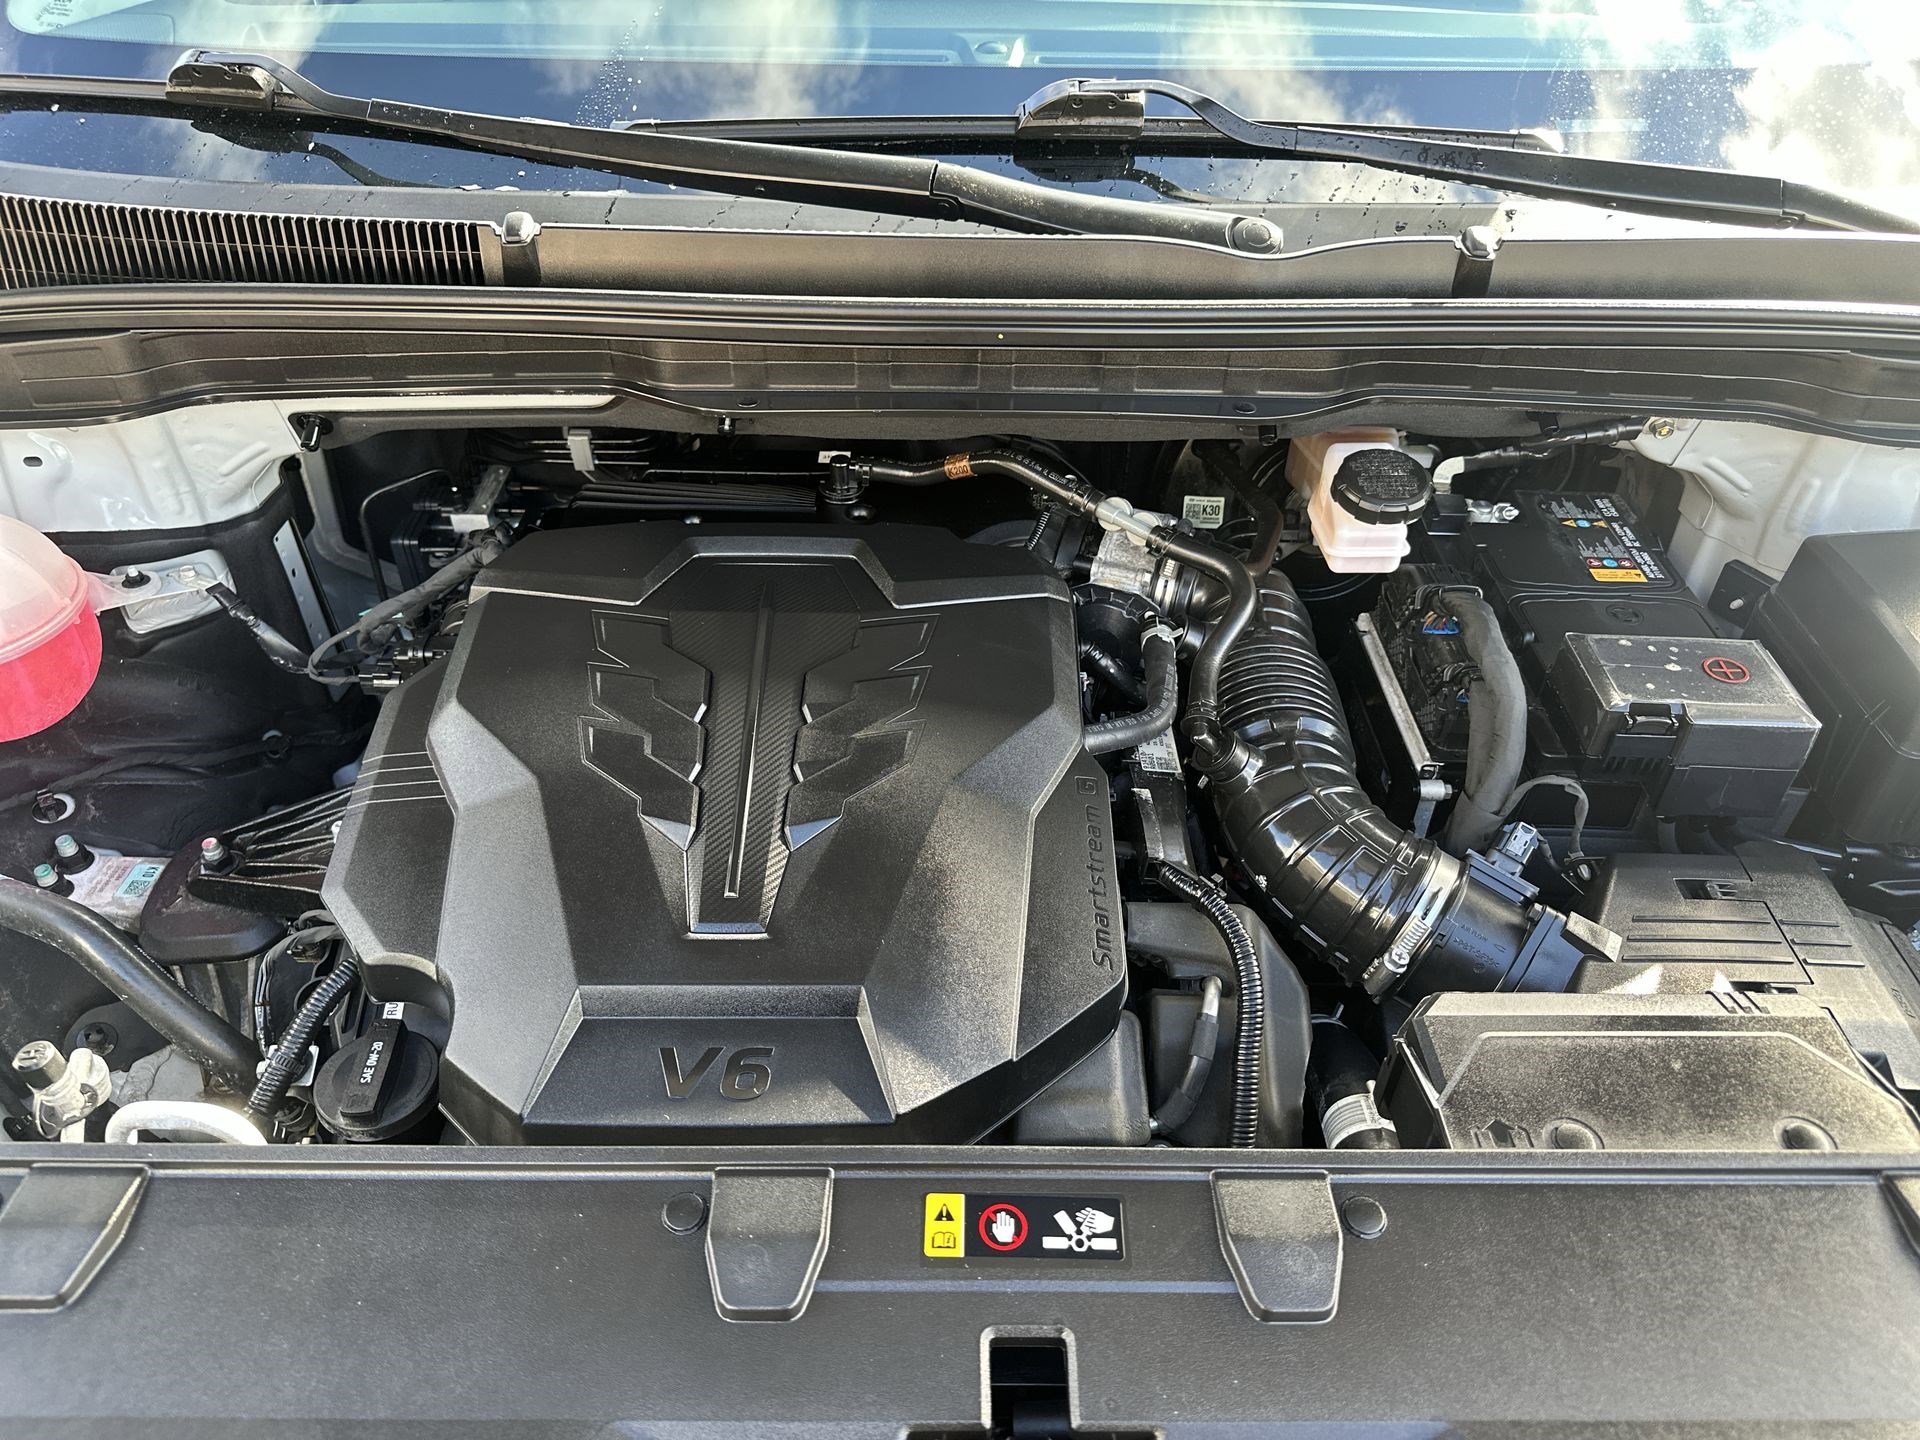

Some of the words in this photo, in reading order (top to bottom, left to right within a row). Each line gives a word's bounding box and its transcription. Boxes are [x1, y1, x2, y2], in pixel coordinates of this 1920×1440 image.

[948, 464, 969, 478] K200
[1201, 504, 1220, 516] K30
[142, 866, 160, 878] K10
[1085, 803, 1113, 971] Smartstream
[366, 1041, 384, 1067] 0W-20
[360, 1066, 375, 1084] SAE
[658, 1046, 776, 1101] V6
